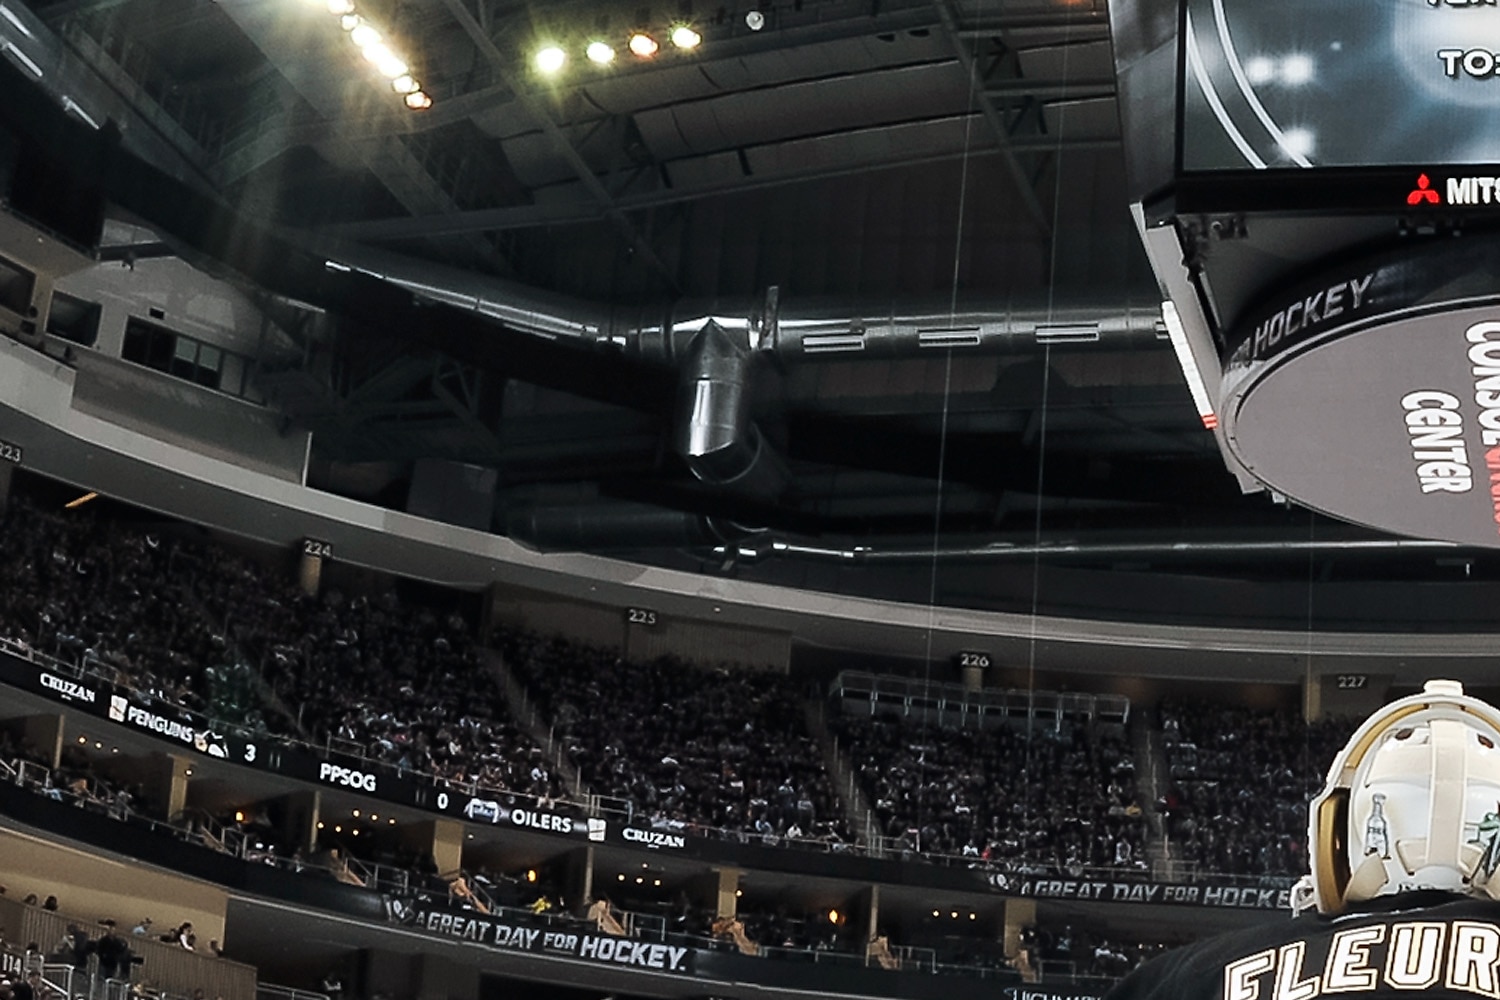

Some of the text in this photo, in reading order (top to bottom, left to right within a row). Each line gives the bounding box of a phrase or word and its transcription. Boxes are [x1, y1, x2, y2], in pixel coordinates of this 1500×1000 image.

[1400, 390, 1473, 494] CENTER
[304, 540, 331, 557] 224
[629, 608, 656, 625] 225
[960, 652, 990, 668] 226
[39, 672, 96, 703] CRUZAN
[1338, 676, 1367, 689] 227
[127, 705, 256, 762] PENGUINS 3
[320, 762, 377, 792] PPSOG
[437, 793, 449, 810] 0
[510, 808, 572, 834] OILERS
[621, 827, 685, 848] CRUZAN
[1033, 881, 1107, 899] GREAT
[1112, 883, 1159, 902] DAY
[1163, 886, 1199, 902] FOR
[1203, 886, 1291, 909] HOCKE
[426, 911, 492, 942] GREAT
[494, 924, 540, 950] DAY
[543, 932, 579, 952] FOR
[579, 935, 688, 972] HOCKEY.
